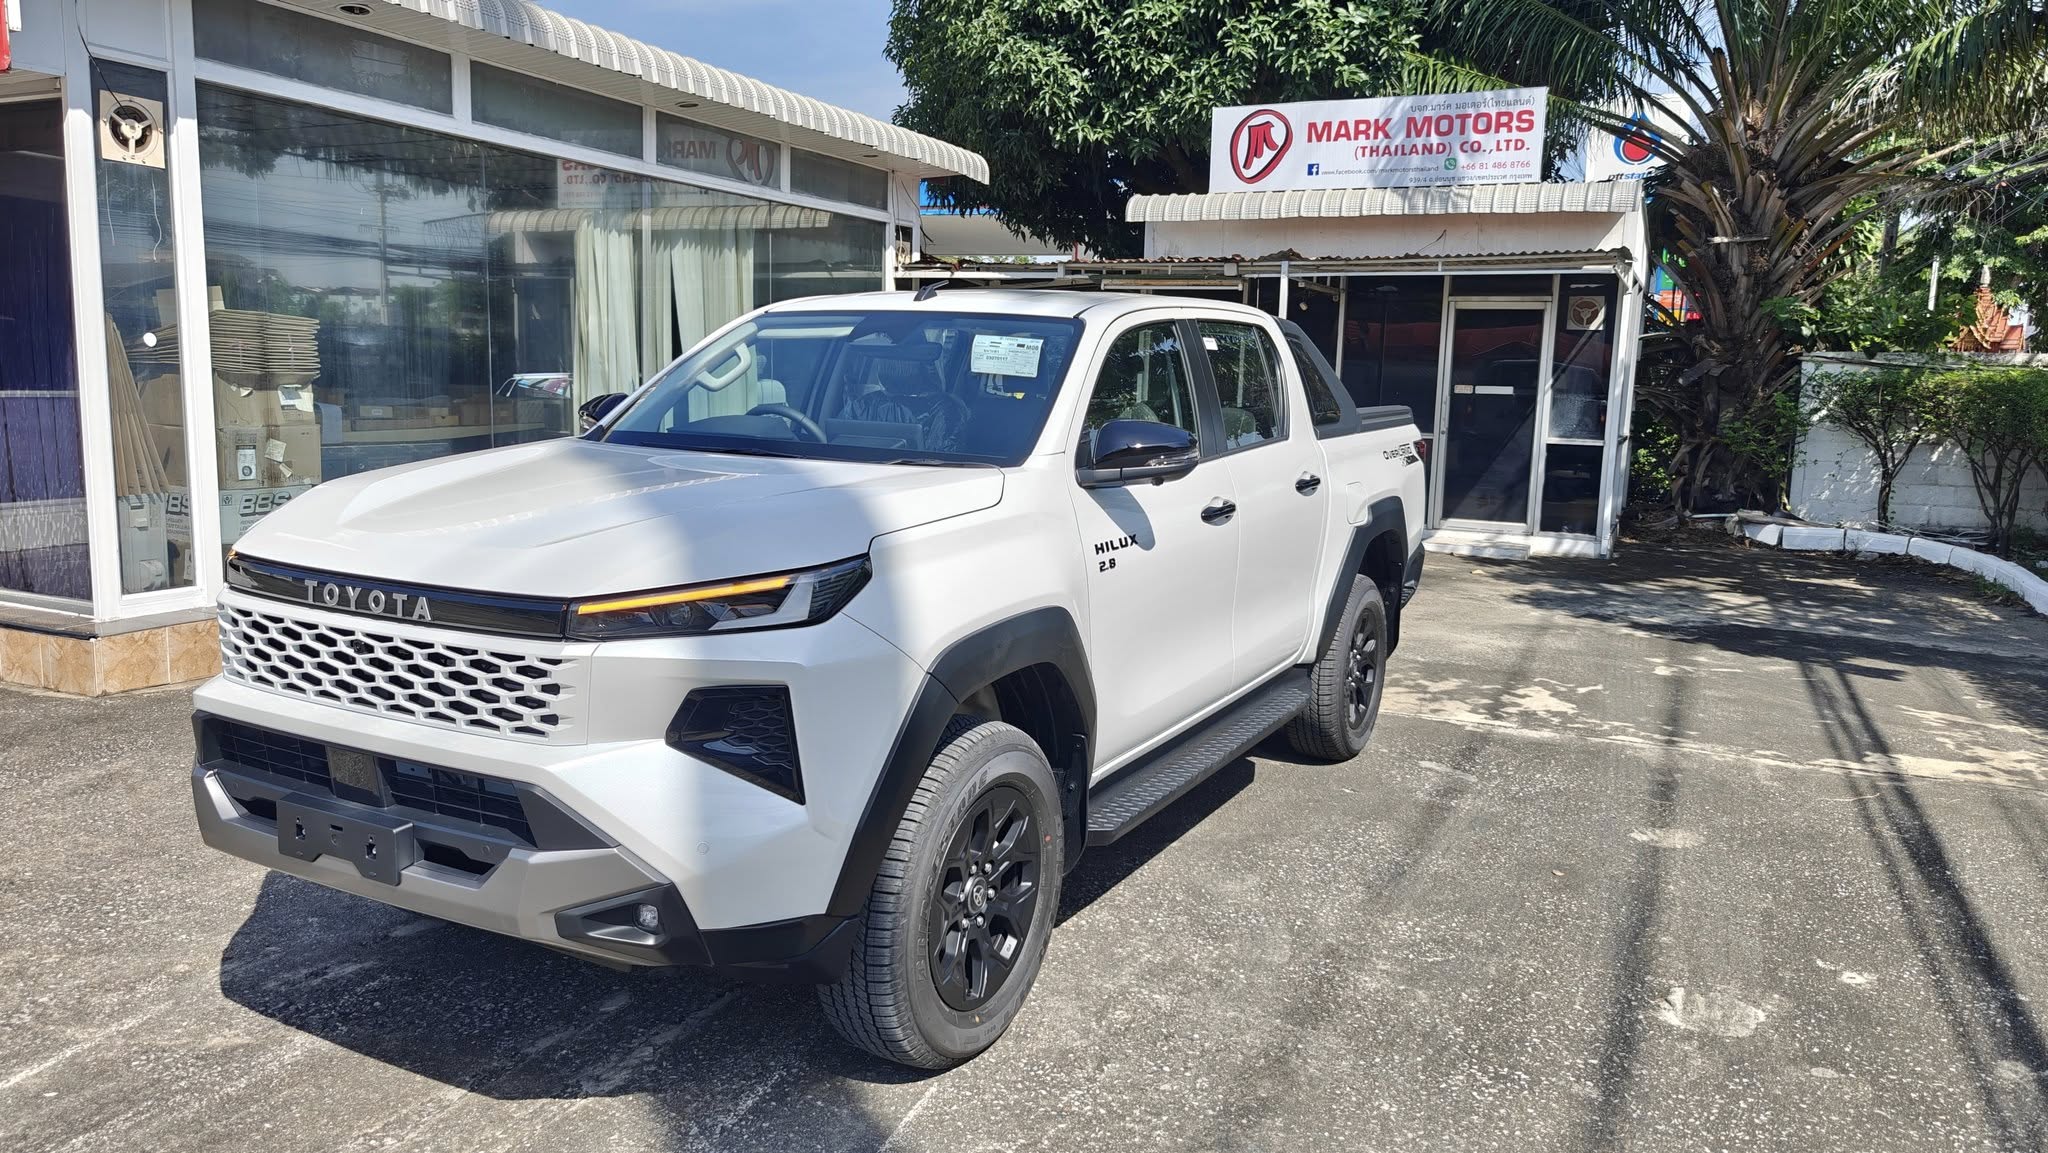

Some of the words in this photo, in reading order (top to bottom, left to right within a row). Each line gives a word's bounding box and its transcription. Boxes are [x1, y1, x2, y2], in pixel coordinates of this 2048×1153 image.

[1306, 118, 1393, 144] MARK
[1405, 110, 1535, 139] MOTORS
[1354, 142, 1452, 161] (THAILAND)
[1459, 138, 1531, 155] CO.,LTD.
[1460, 162, 1477, 171] +66
[1478, 162, 1489, 170] 81
[1491, 161, 1507, 170] 486
[1510, 160, 1531, 169] 8766
[1094, 533, 1139, 556] HILUX
[1098, 557, 1117, 573] 2.8
[304, 578, 432, 621] TOYOTA
